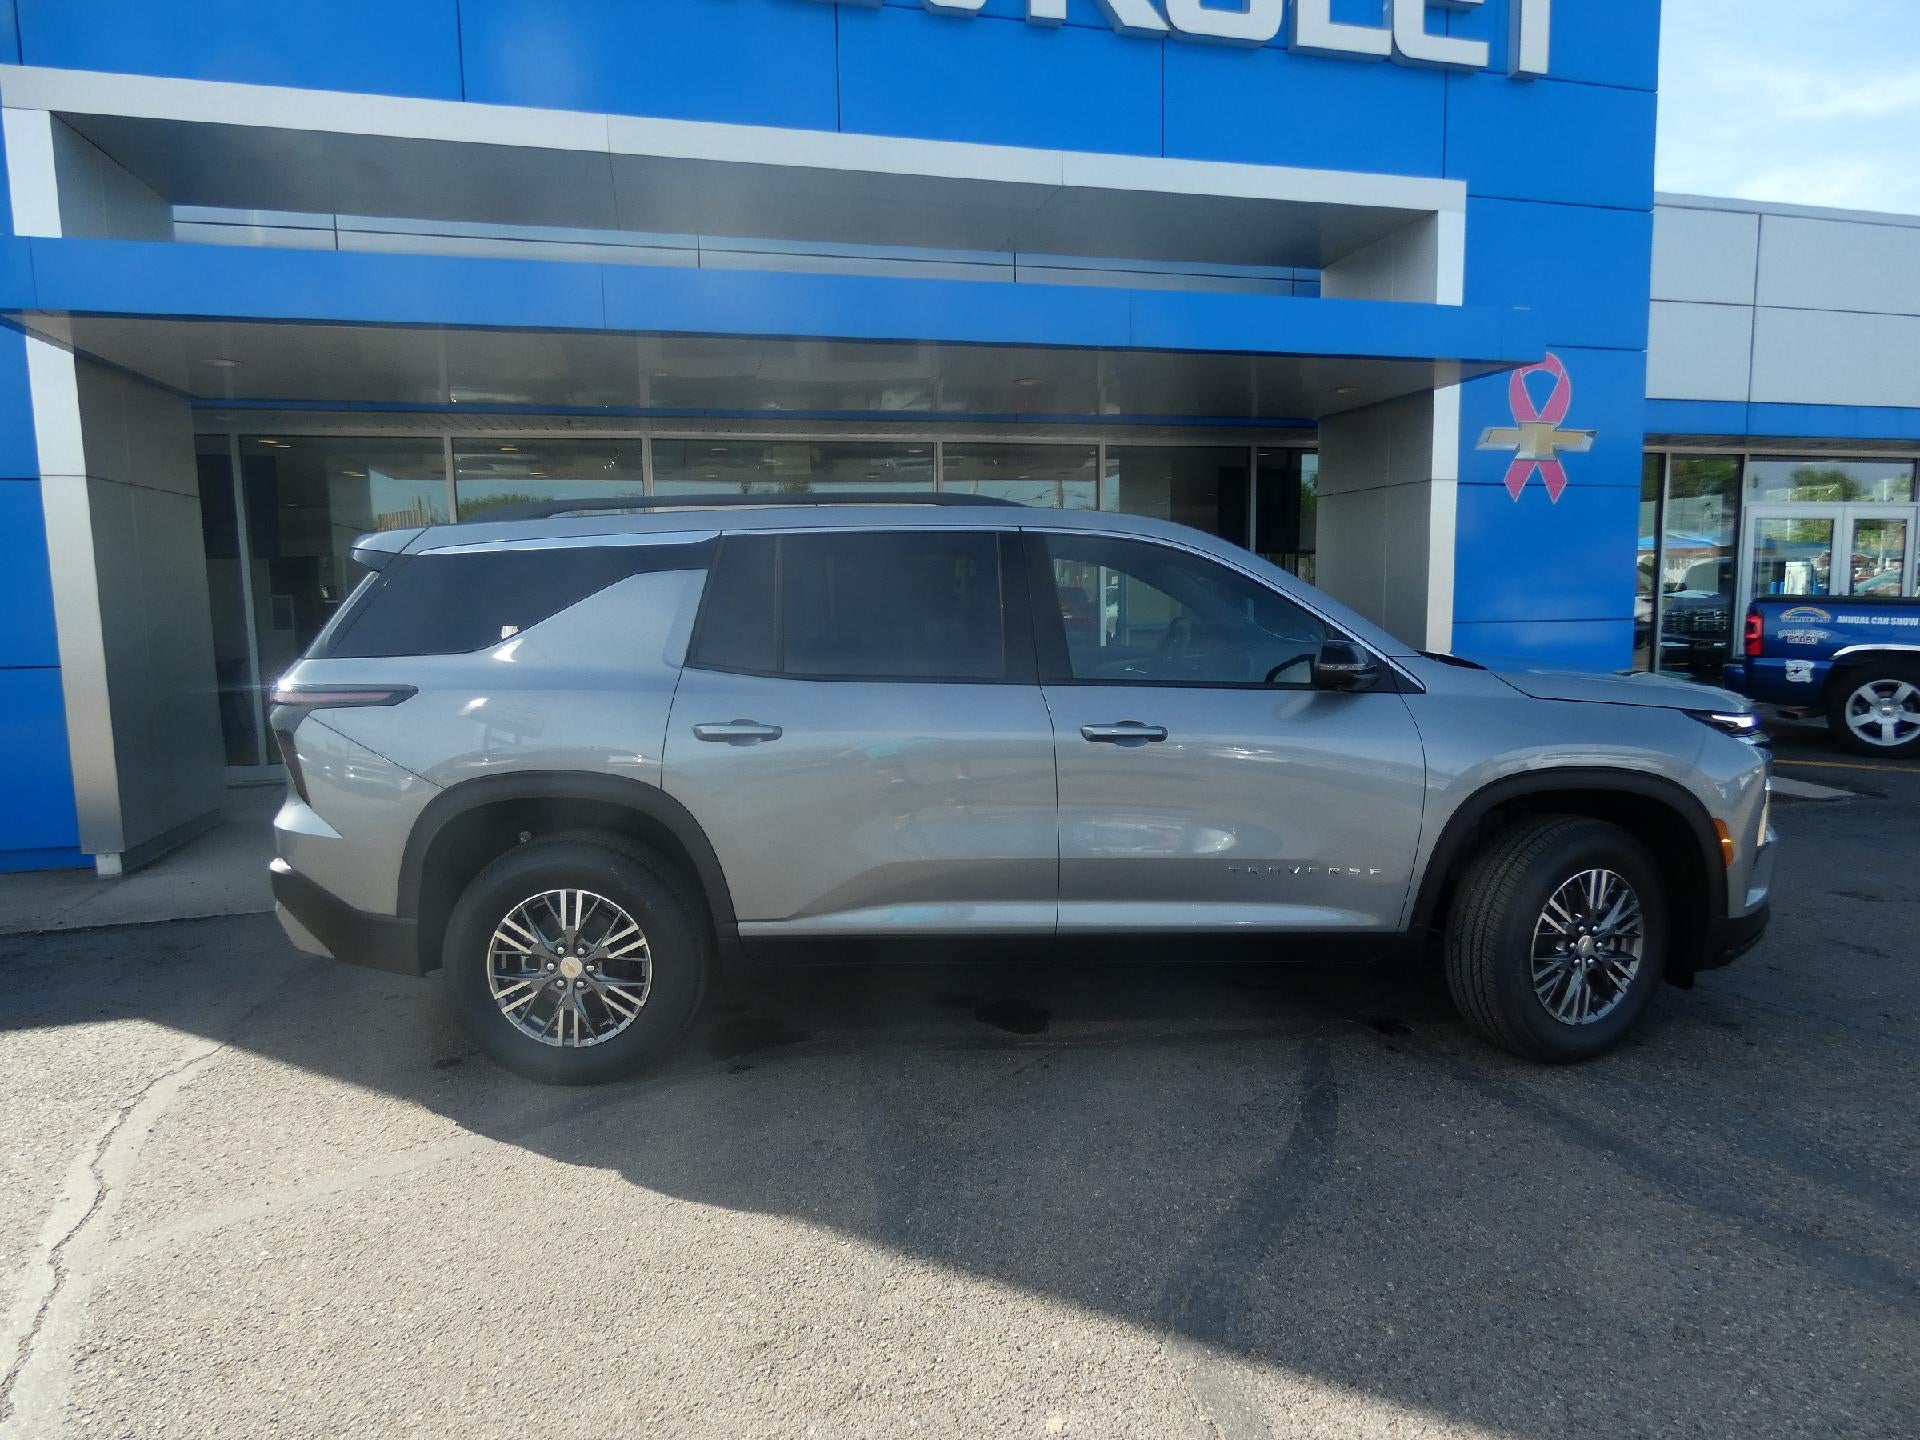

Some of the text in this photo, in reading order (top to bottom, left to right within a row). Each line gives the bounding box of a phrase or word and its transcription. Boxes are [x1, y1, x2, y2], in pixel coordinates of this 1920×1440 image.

[1836, 615, 1870, 625] ANNUAL
[1870, 616, 1889, 625] CAR
[1890, 617, 1919, 626] SHOW
